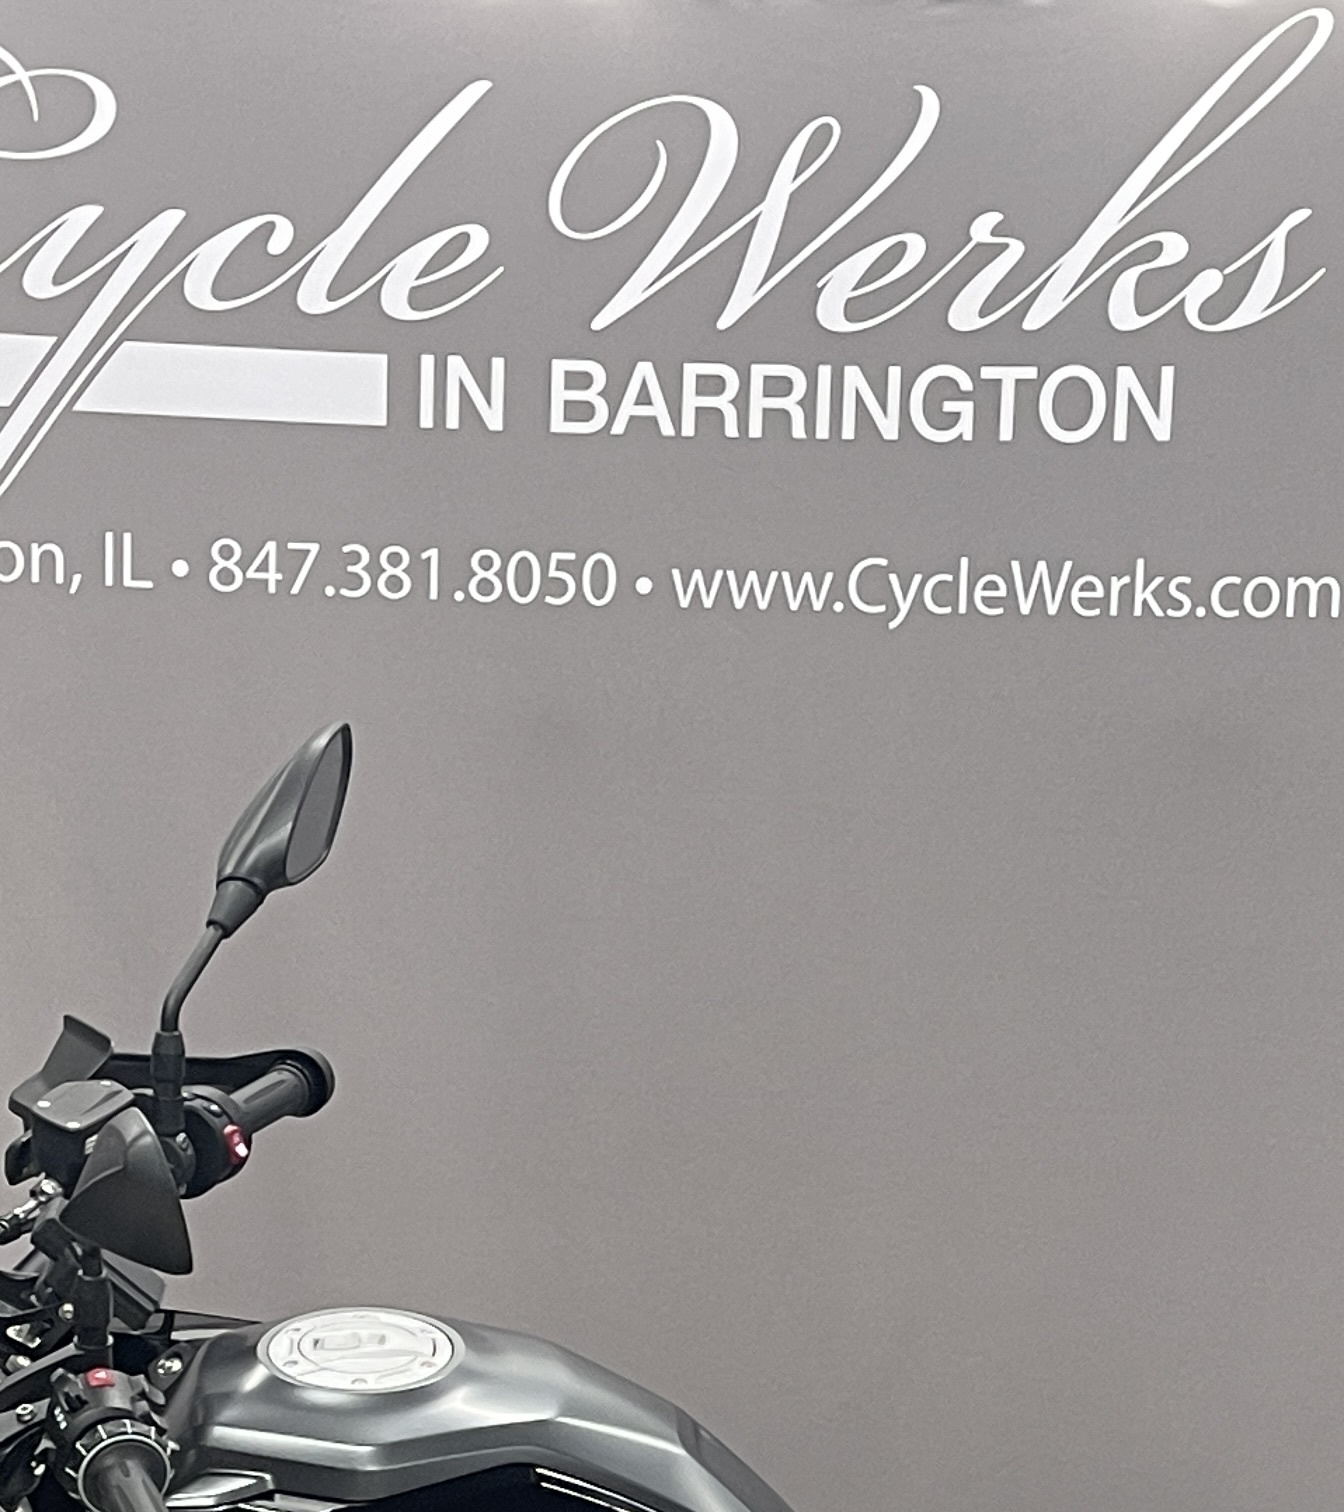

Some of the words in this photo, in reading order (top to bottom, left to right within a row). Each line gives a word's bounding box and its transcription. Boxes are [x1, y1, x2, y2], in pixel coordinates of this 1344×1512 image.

[548, 7, 1335, 333] Werks
[419, 354, 505, 432] IN
[549, 358, 1175, 444] BARRINGTON
[103, 531, 155, 590] IL
[208, 537, 617, 607] 847.381.8050
[671, 556, 1342, 630] www.CycleWerks.com
